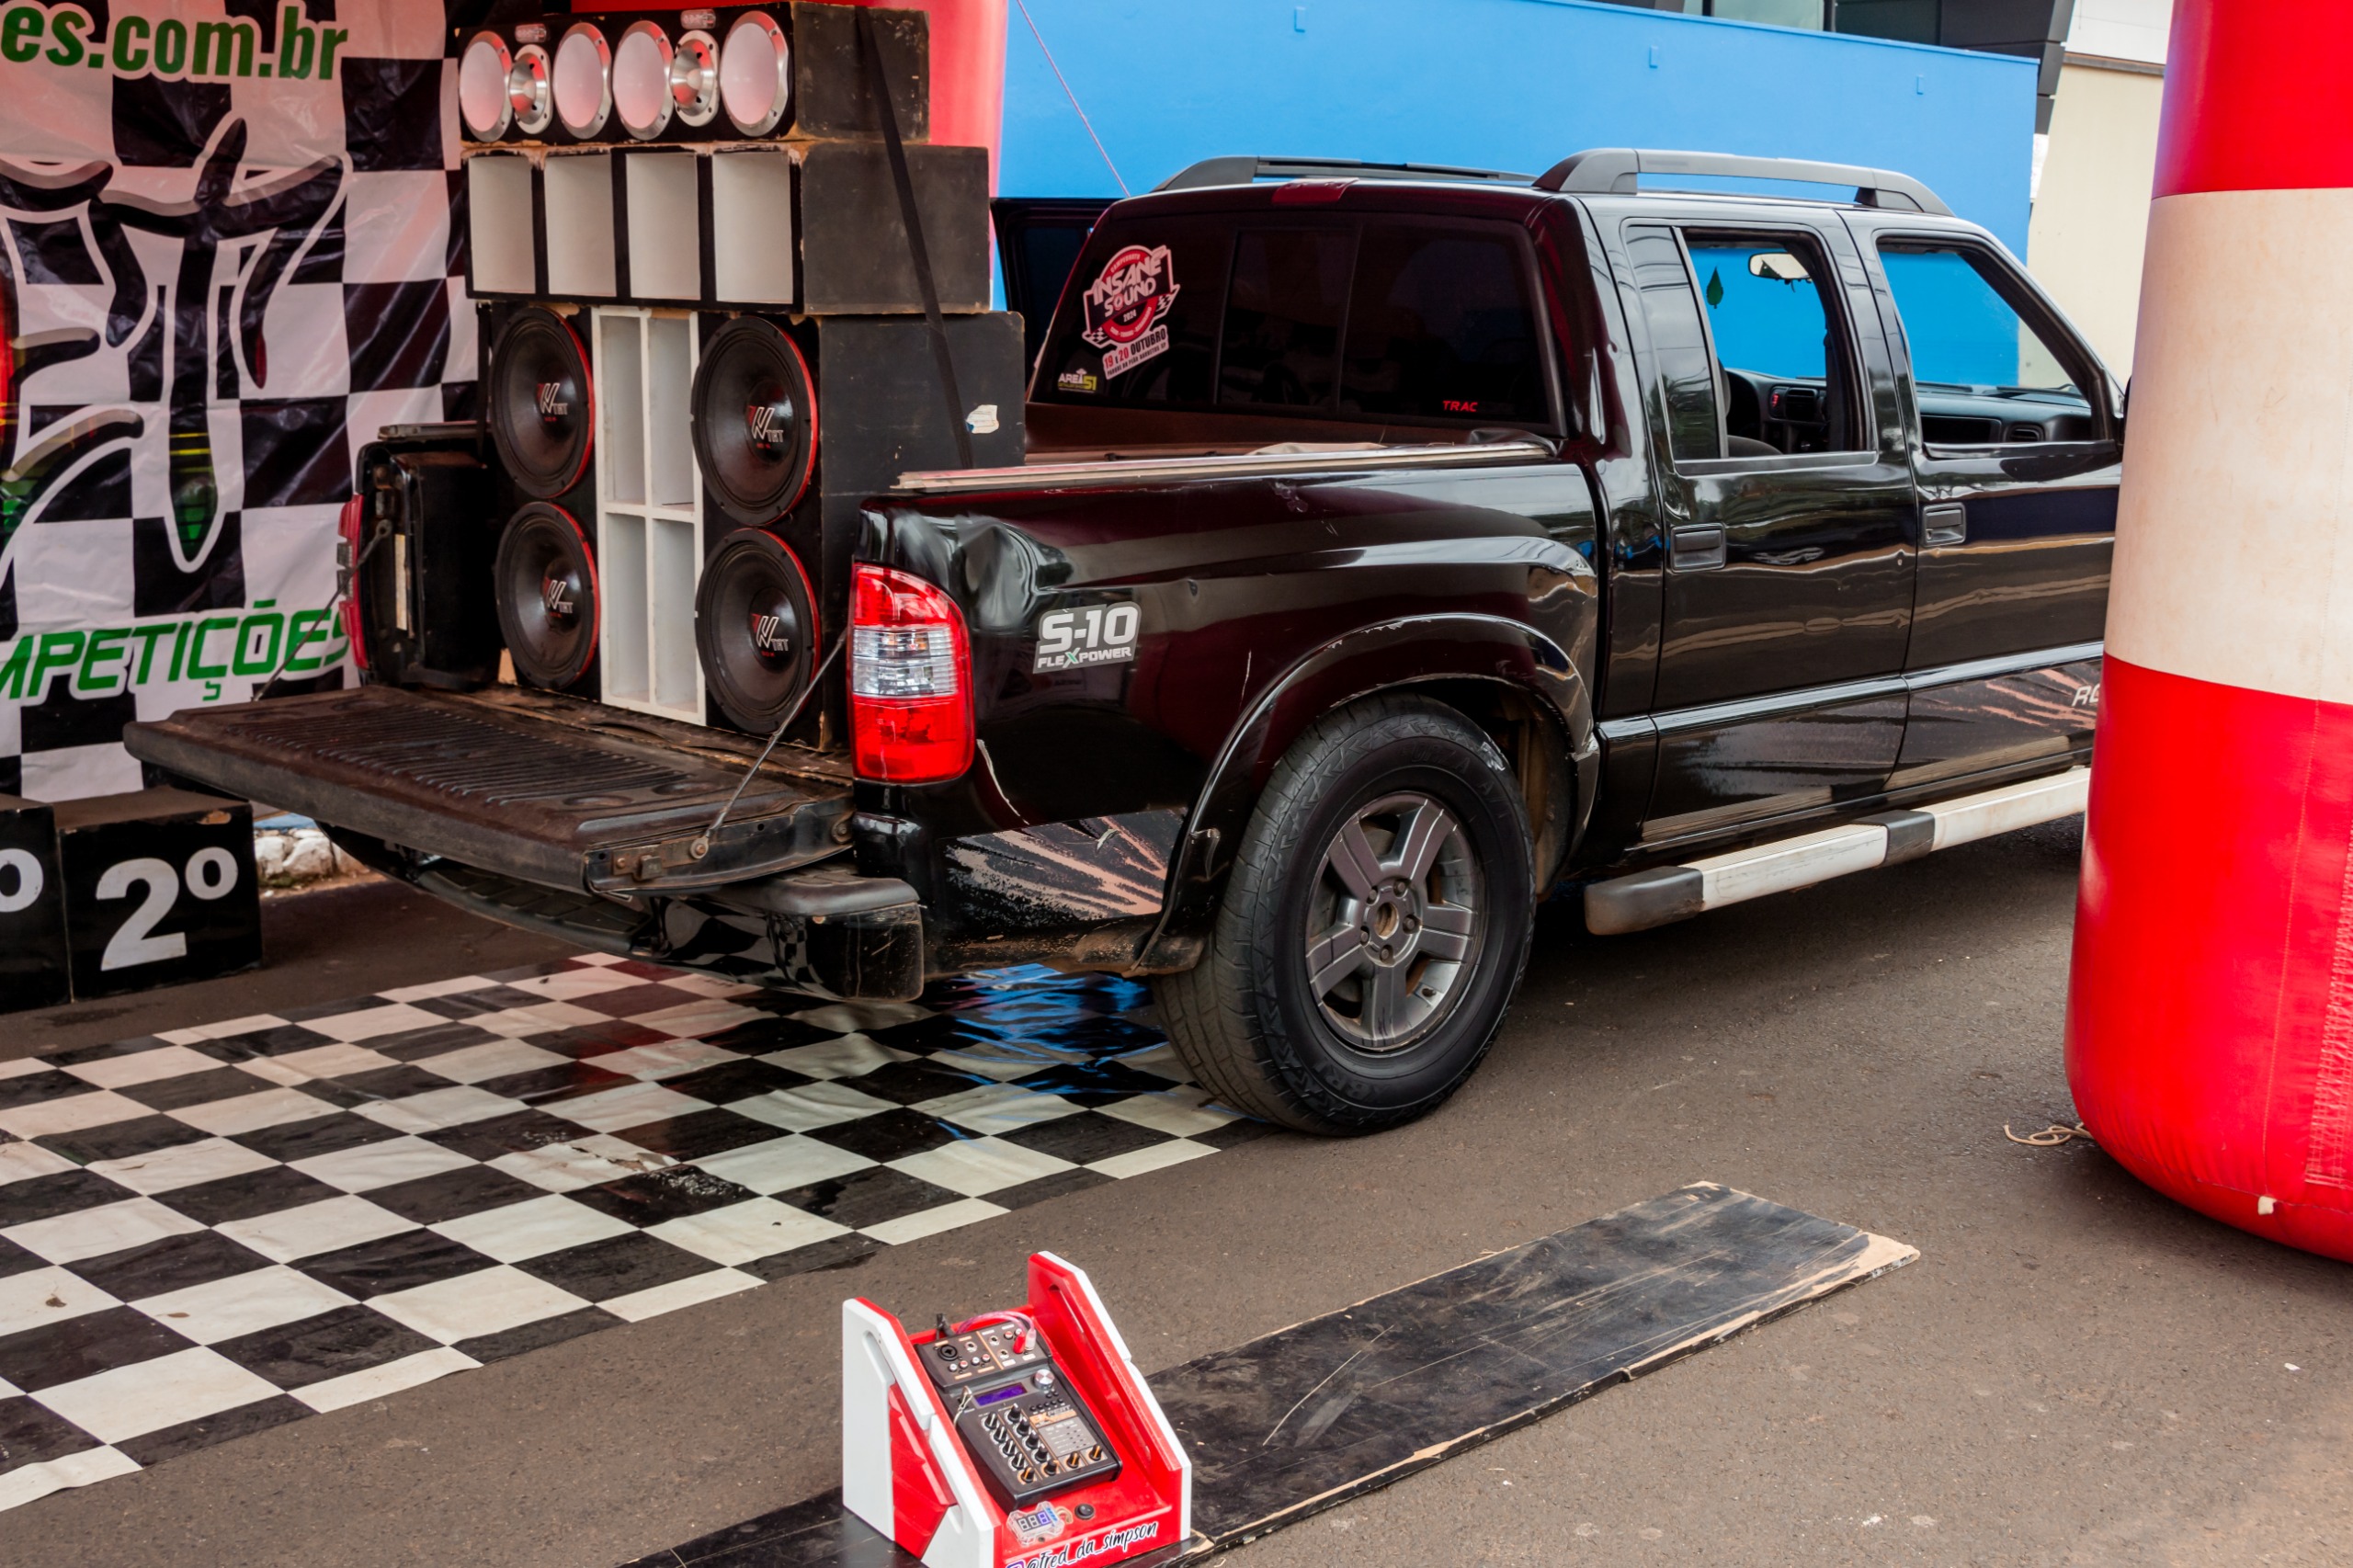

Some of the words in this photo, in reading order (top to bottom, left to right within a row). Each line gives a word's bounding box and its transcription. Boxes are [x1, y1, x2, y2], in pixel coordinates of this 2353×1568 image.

[0, 6, 348, 80] es.com.br
[1093, 244, 1165, 306] INSANE
[1104, 277, 1156, 318] SOUND
[1104, 355, 1114, 369] 19
[1118, 347, 1130, 362] 20
[1130, 328, 1166, 356] OUTUBRO
[1443, 400, 1478, 413] TRAC
[1039, 606, 1139, 654] S-10
[1037, 647, 1132, 669] FLEXPOWER
